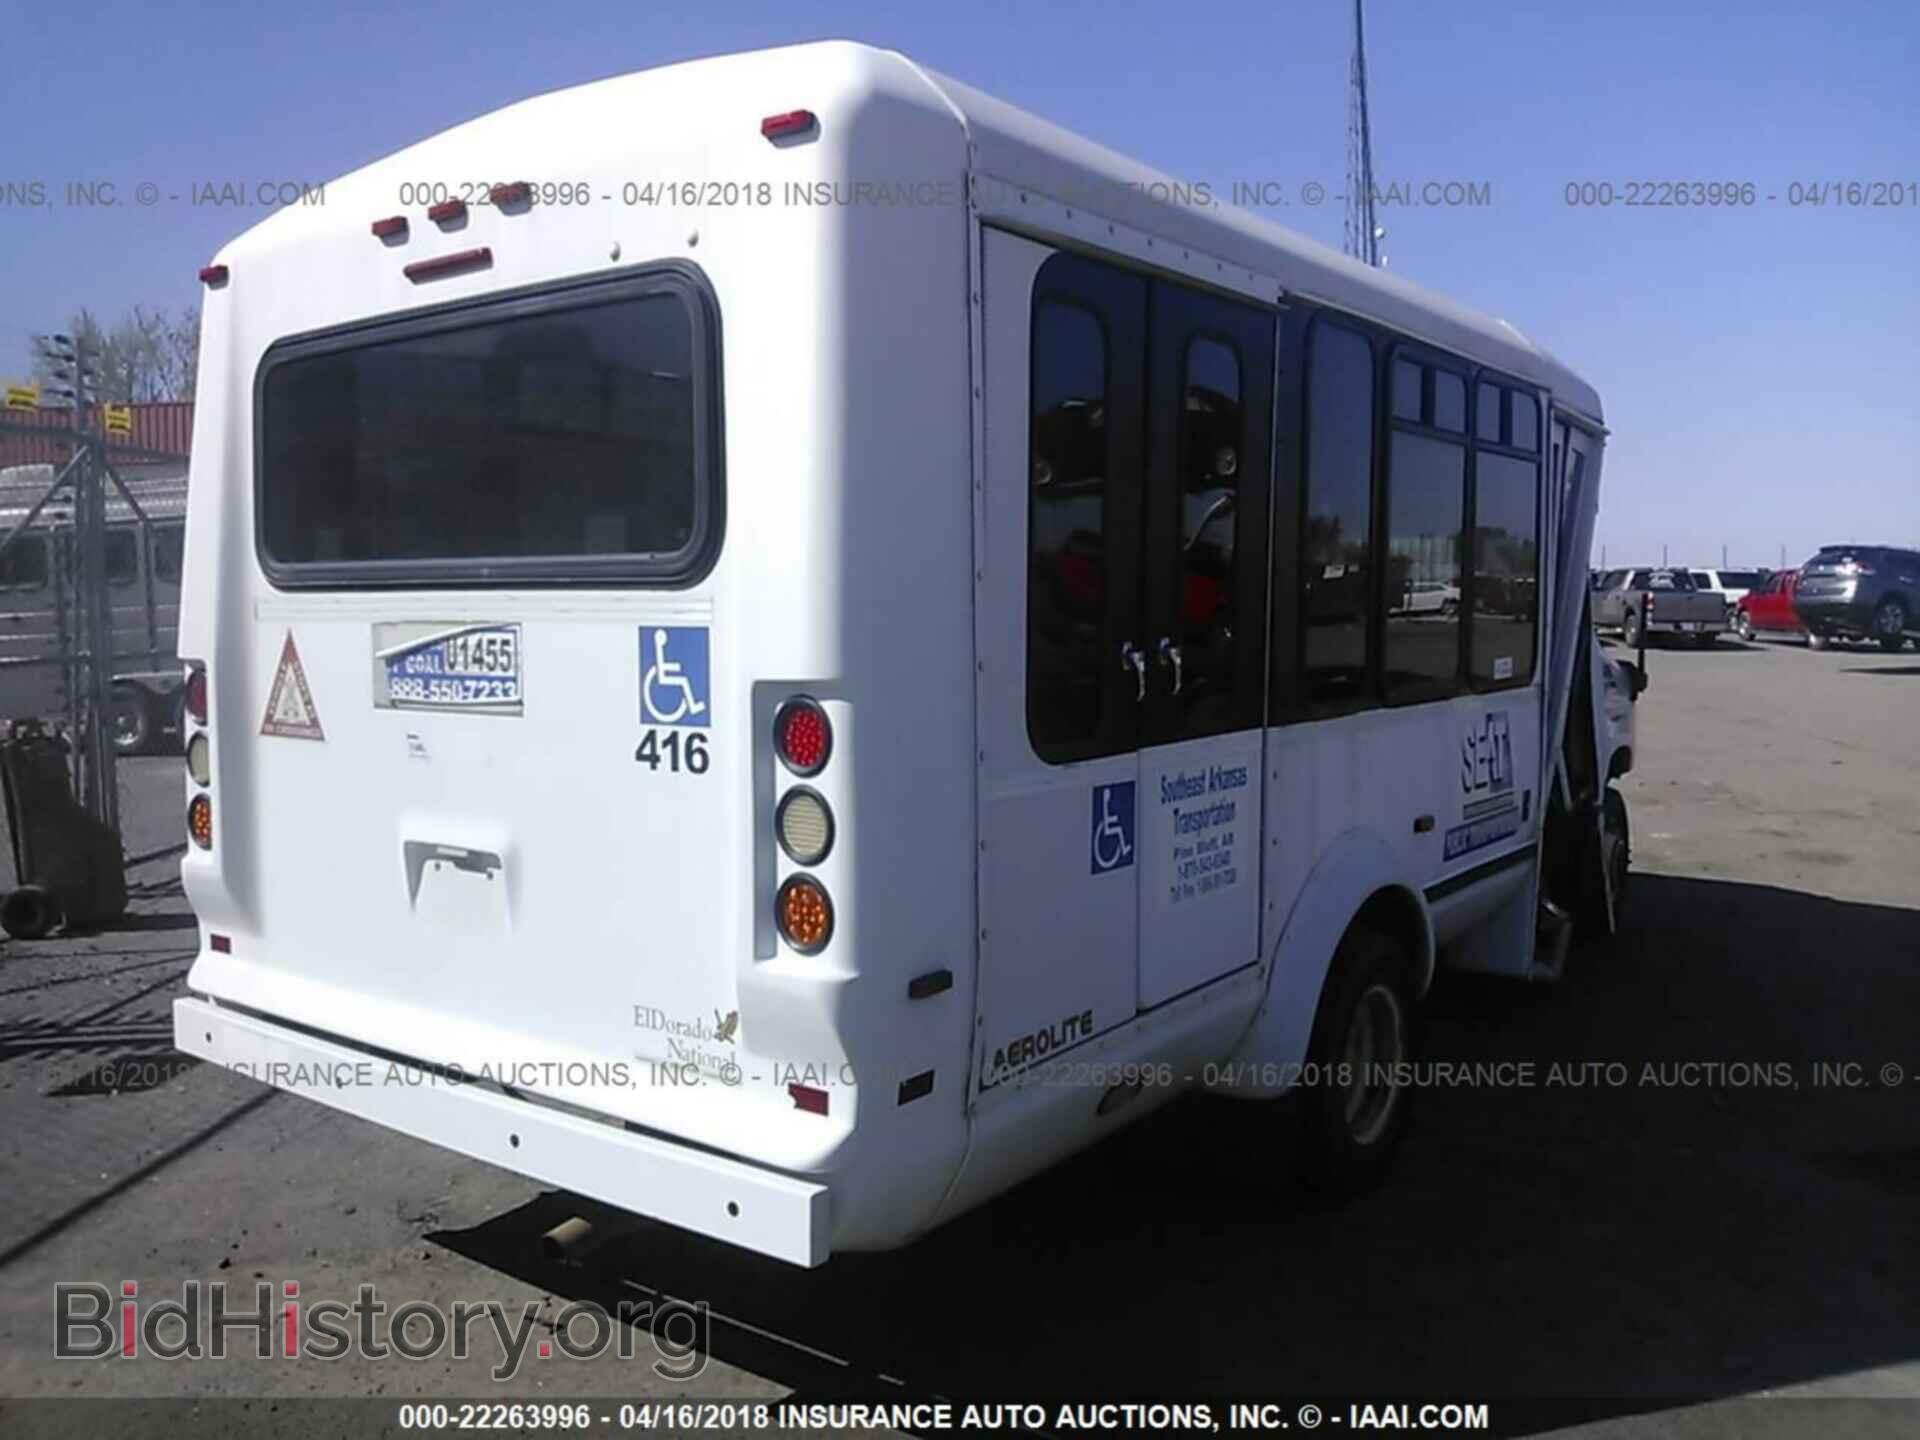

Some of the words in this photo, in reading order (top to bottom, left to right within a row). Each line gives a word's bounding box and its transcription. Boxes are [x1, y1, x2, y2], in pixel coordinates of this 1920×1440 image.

[635, 728, 710, 775] 416
[1208, 764, 1248, 792] Arkansas
[633, 1004, 712, 1042] ElDorado
[667, 1037, 736, 1073] National
[991, 1009, 1093, 1080] AEROLITE
